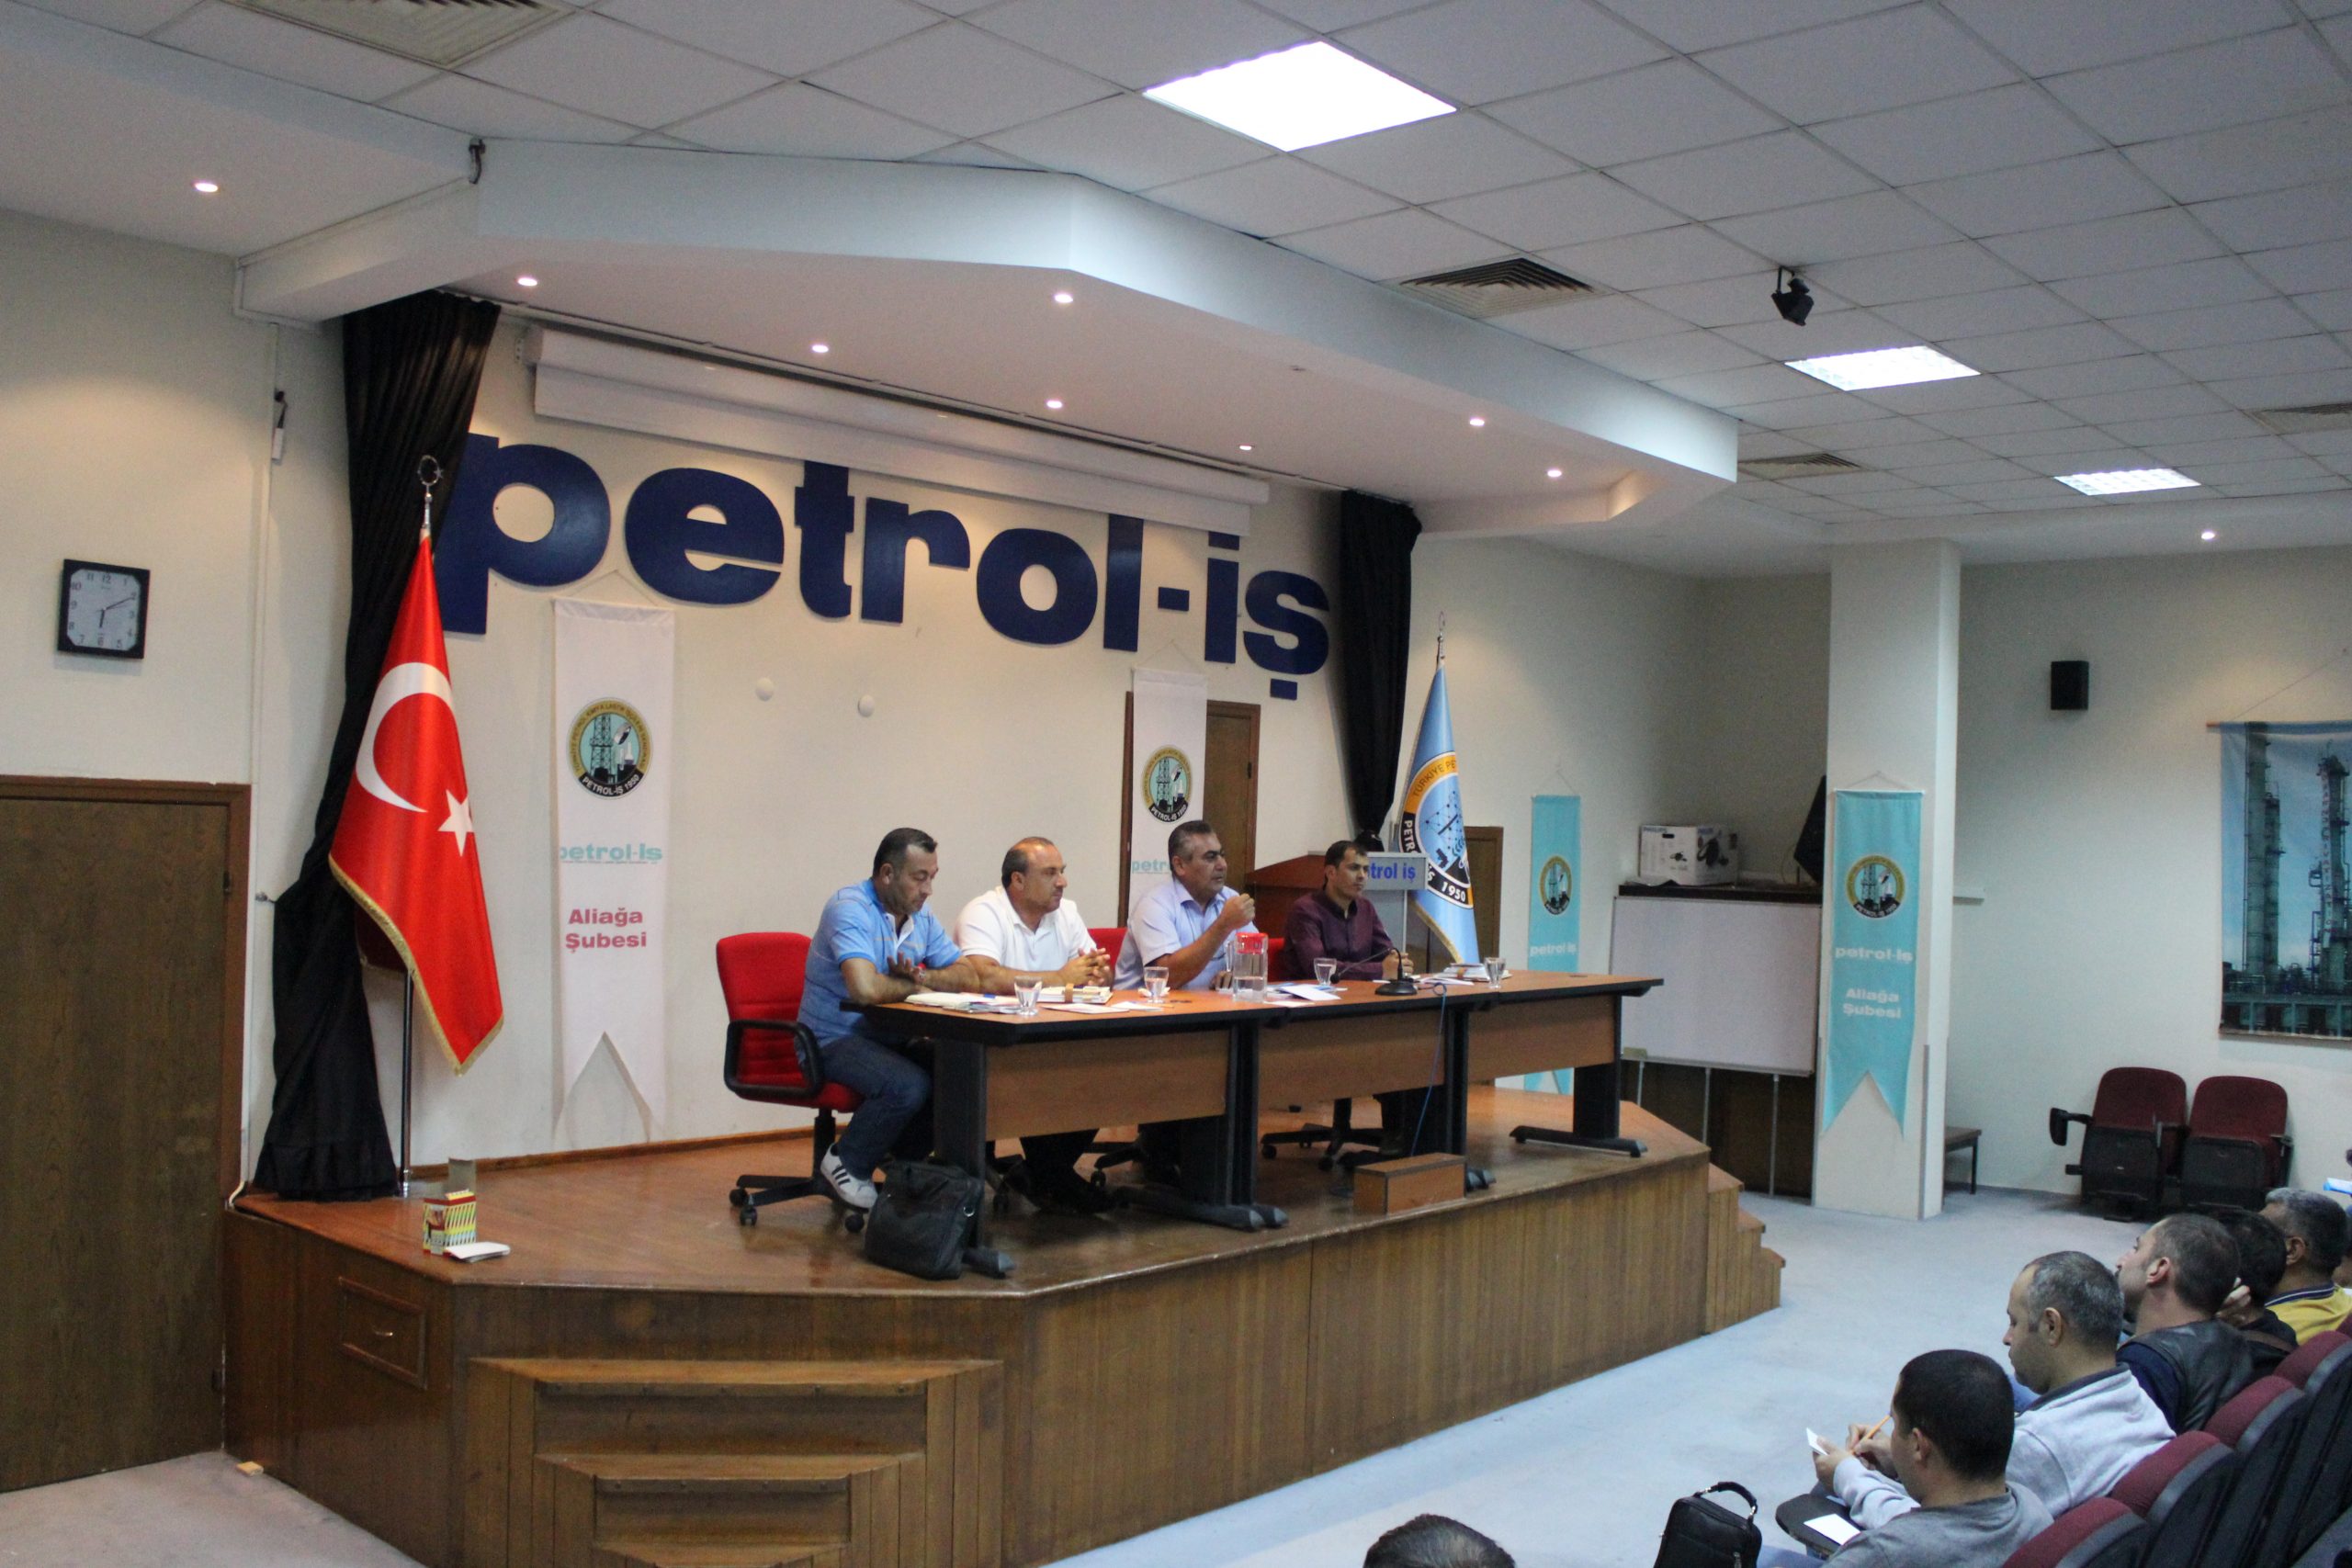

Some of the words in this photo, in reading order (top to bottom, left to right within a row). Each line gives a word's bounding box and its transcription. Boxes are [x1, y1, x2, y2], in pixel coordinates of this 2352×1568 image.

[434, 432, 1329, 700] petrol-iş
[1131, 859, 1170, 874] petr
[1369, 863, 1397, 879] trol
[1402, 863, 1417, 884] iş
[1441, 882, 1466, 902] 1950
[569, 908, 643, 928] Aliağa
[565, 931, 647, 953] Şubesi
[1846, 987, 1899, 1004] Aliağa
[1843, 1002, 1902, 1019] Şubesi
